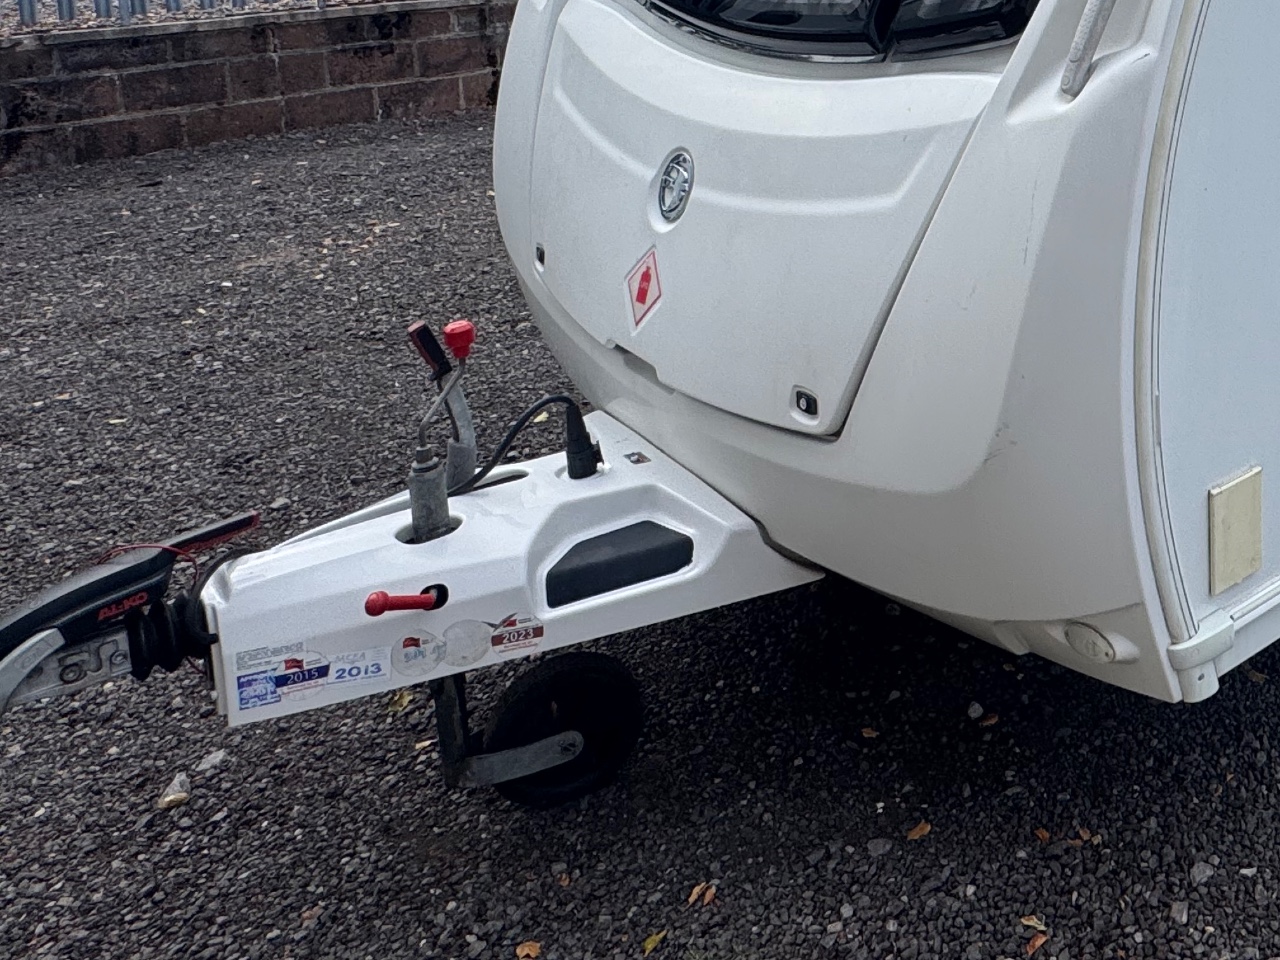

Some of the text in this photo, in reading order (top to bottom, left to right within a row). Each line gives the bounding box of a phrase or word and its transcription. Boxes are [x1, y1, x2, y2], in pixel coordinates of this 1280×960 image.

[97, 591, 148, 621] AL-KO
[502, 629, 534, 644] 2023
[287, 668, 319, 685] 2015
[335, 663, 382, 679] 2013
